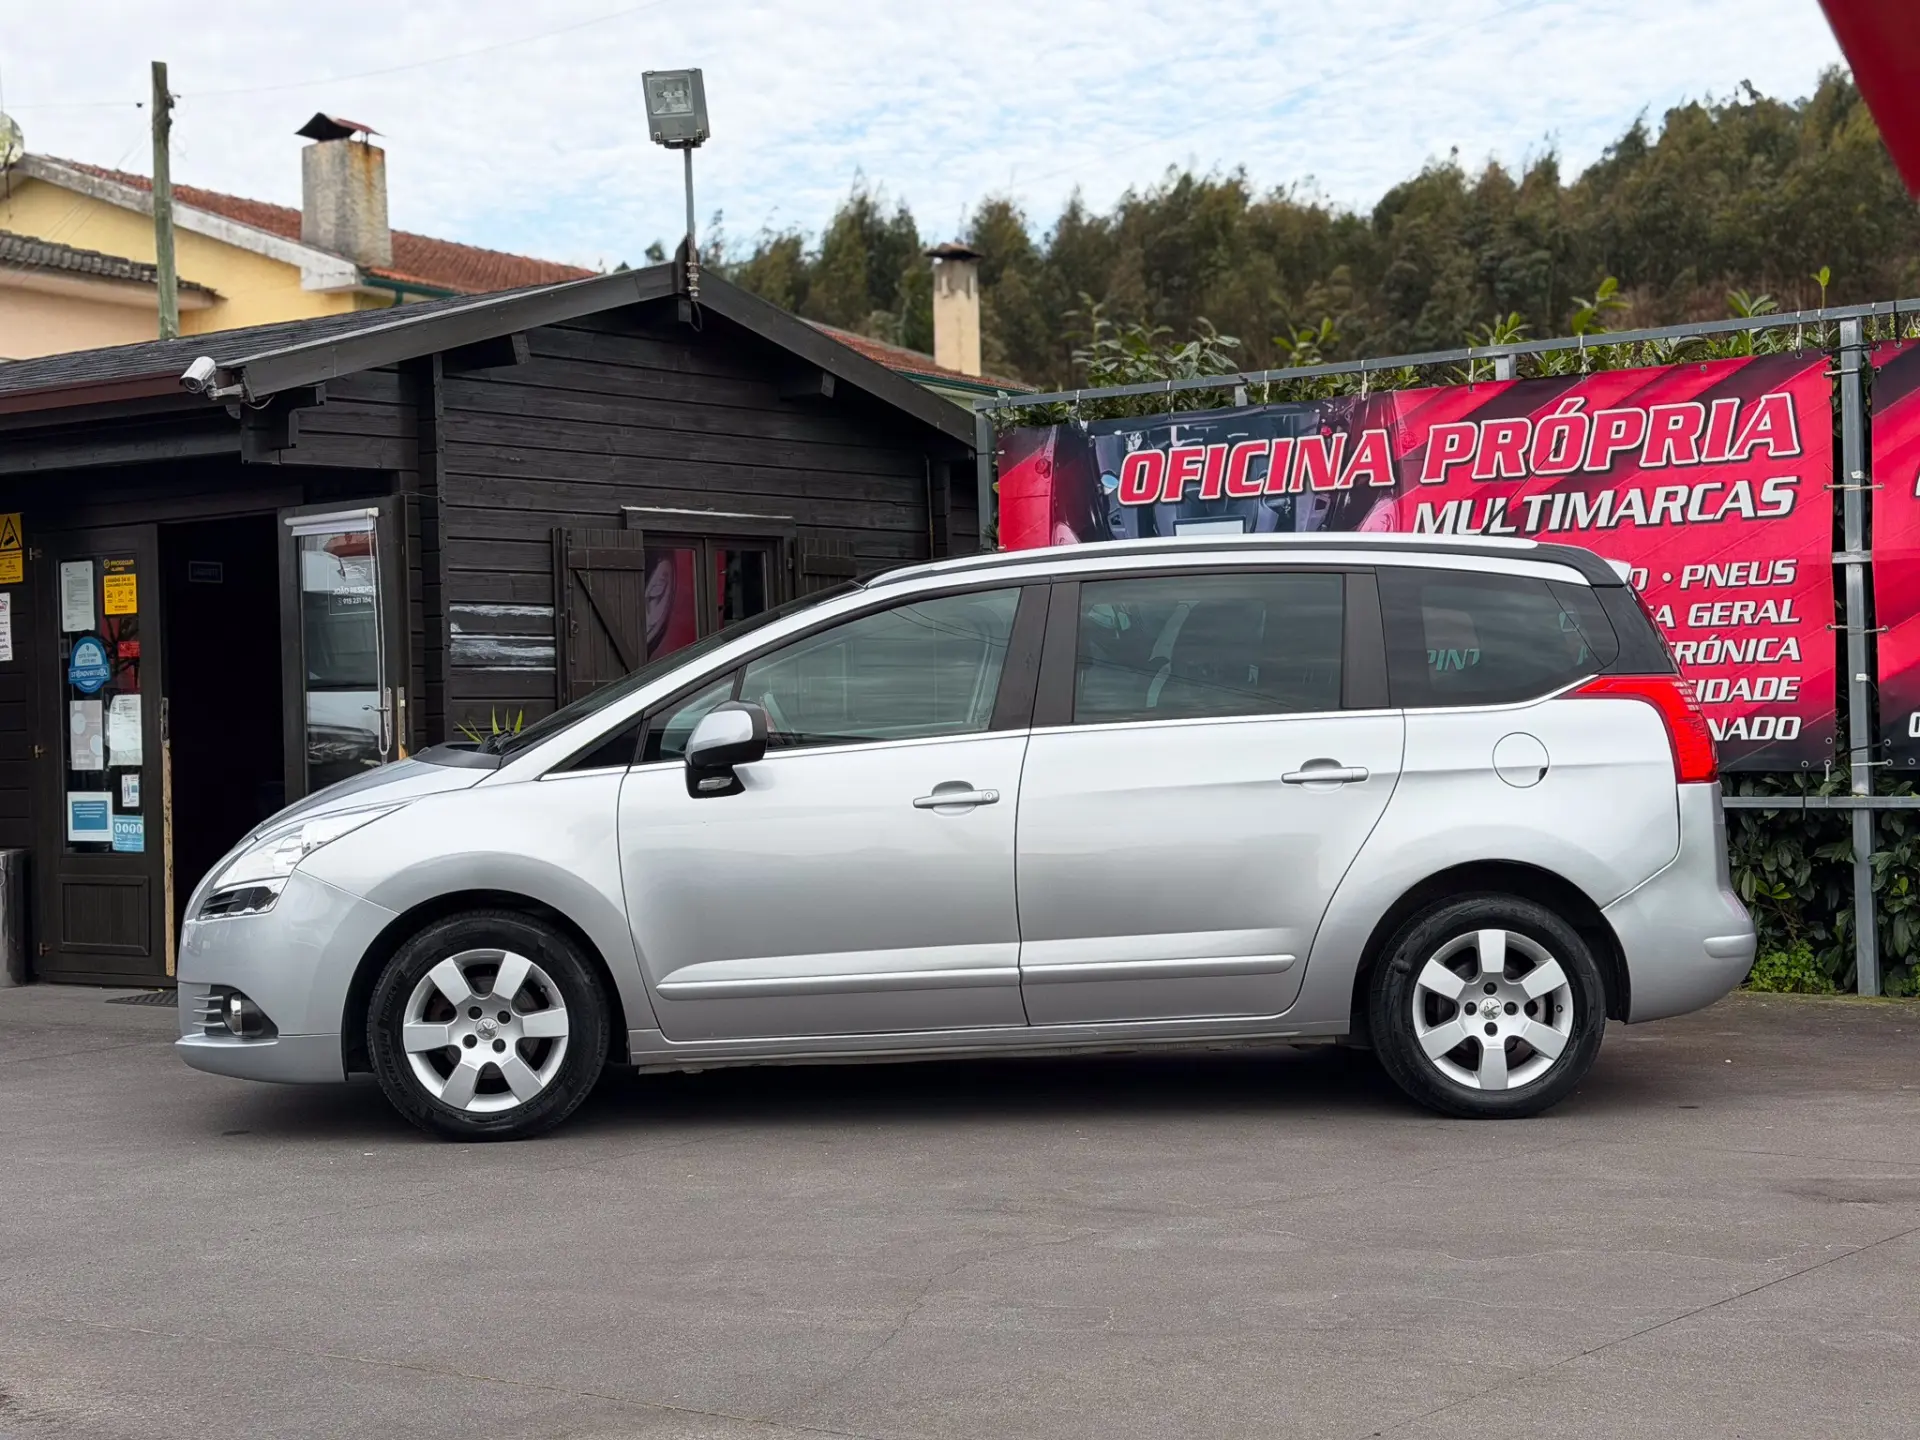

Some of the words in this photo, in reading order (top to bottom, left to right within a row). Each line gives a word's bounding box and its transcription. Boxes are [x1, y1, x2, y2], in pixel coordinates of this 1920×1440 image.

[1117, 428, 1396, 506] OFICINA
[1420, 391, 1802, 484] PRÓPRIA
[1412, 476, 1799, 535] MULTIMARCAS
[1679, 559, 1798, 590] PNEUS
[1687, 599, 1802, 628] GERAL
[1689, 676, 1802, 703] IDADE
